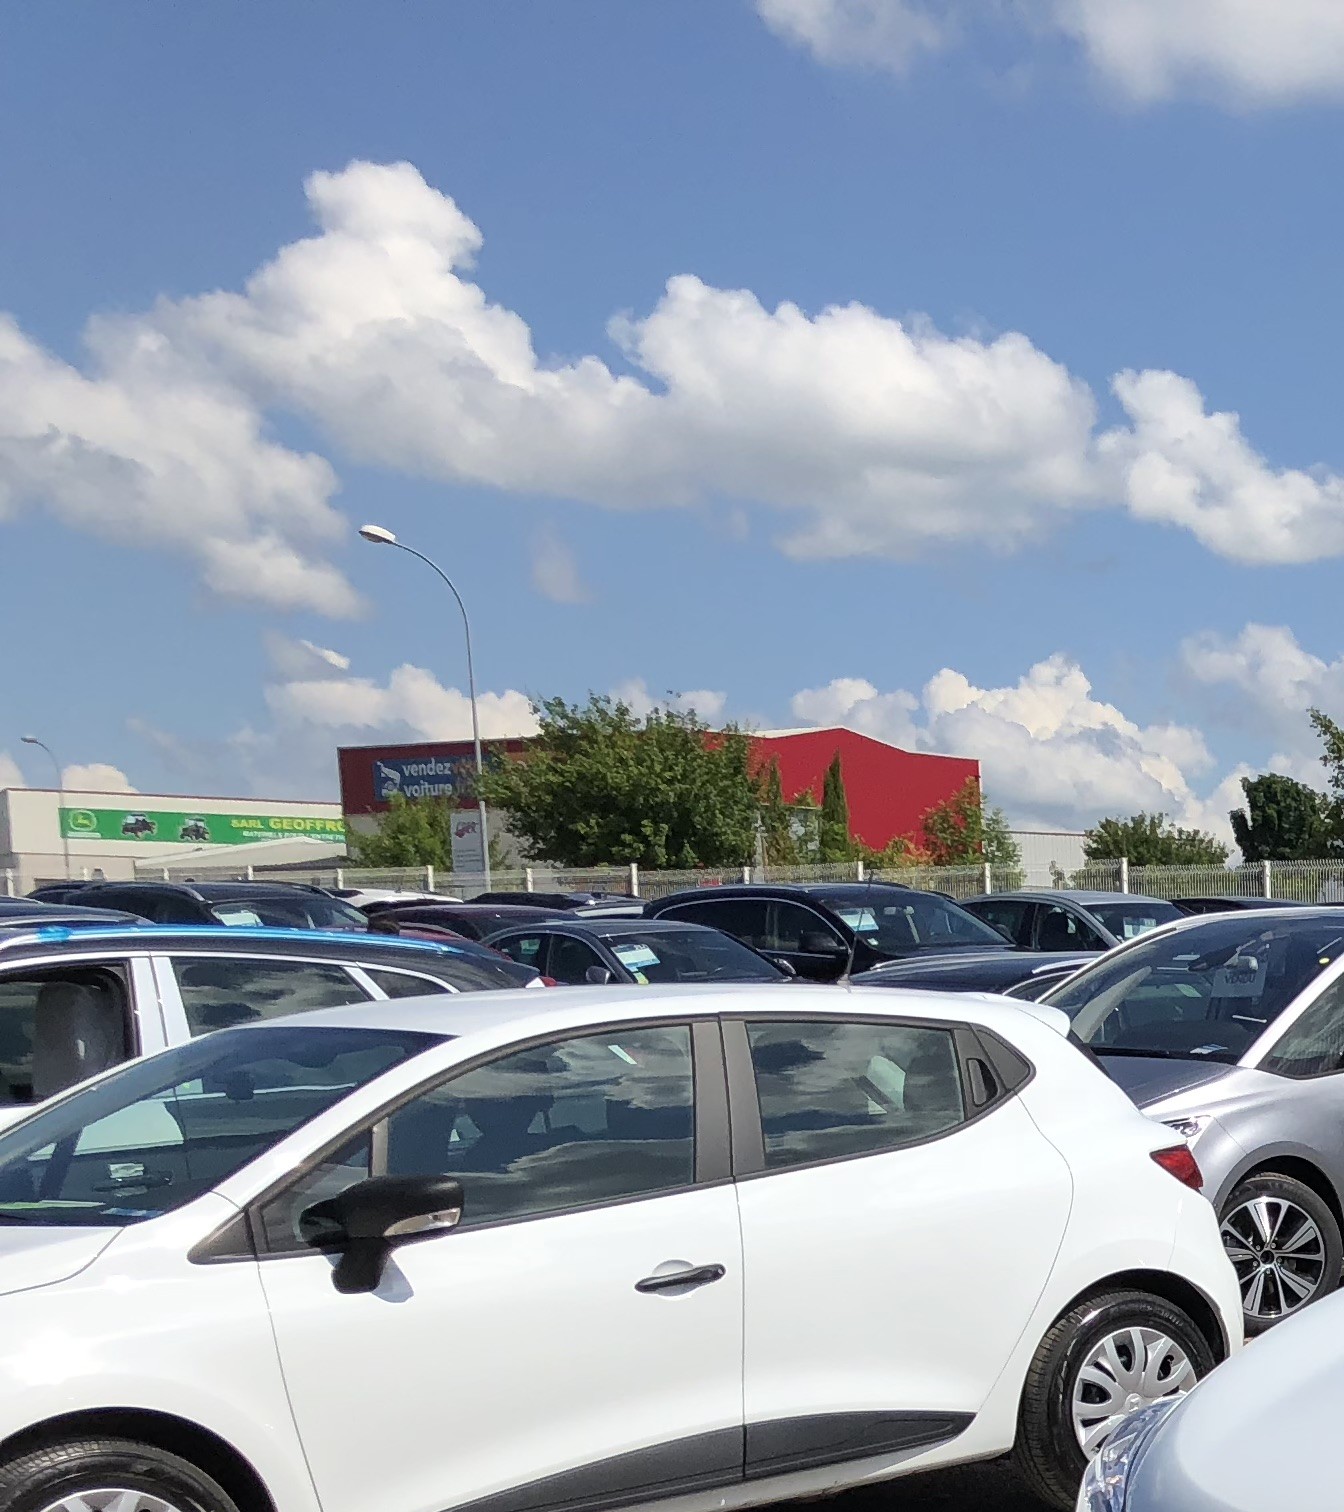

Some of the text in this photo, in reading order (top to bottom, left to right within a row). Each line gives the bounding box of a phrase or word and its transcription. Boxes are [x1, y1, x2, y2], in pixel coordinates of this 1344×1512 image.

[402, 757, 451, 776] vendez
[403, 780, 453, 797] voiture
[230, 819, 264, 829] SARL
